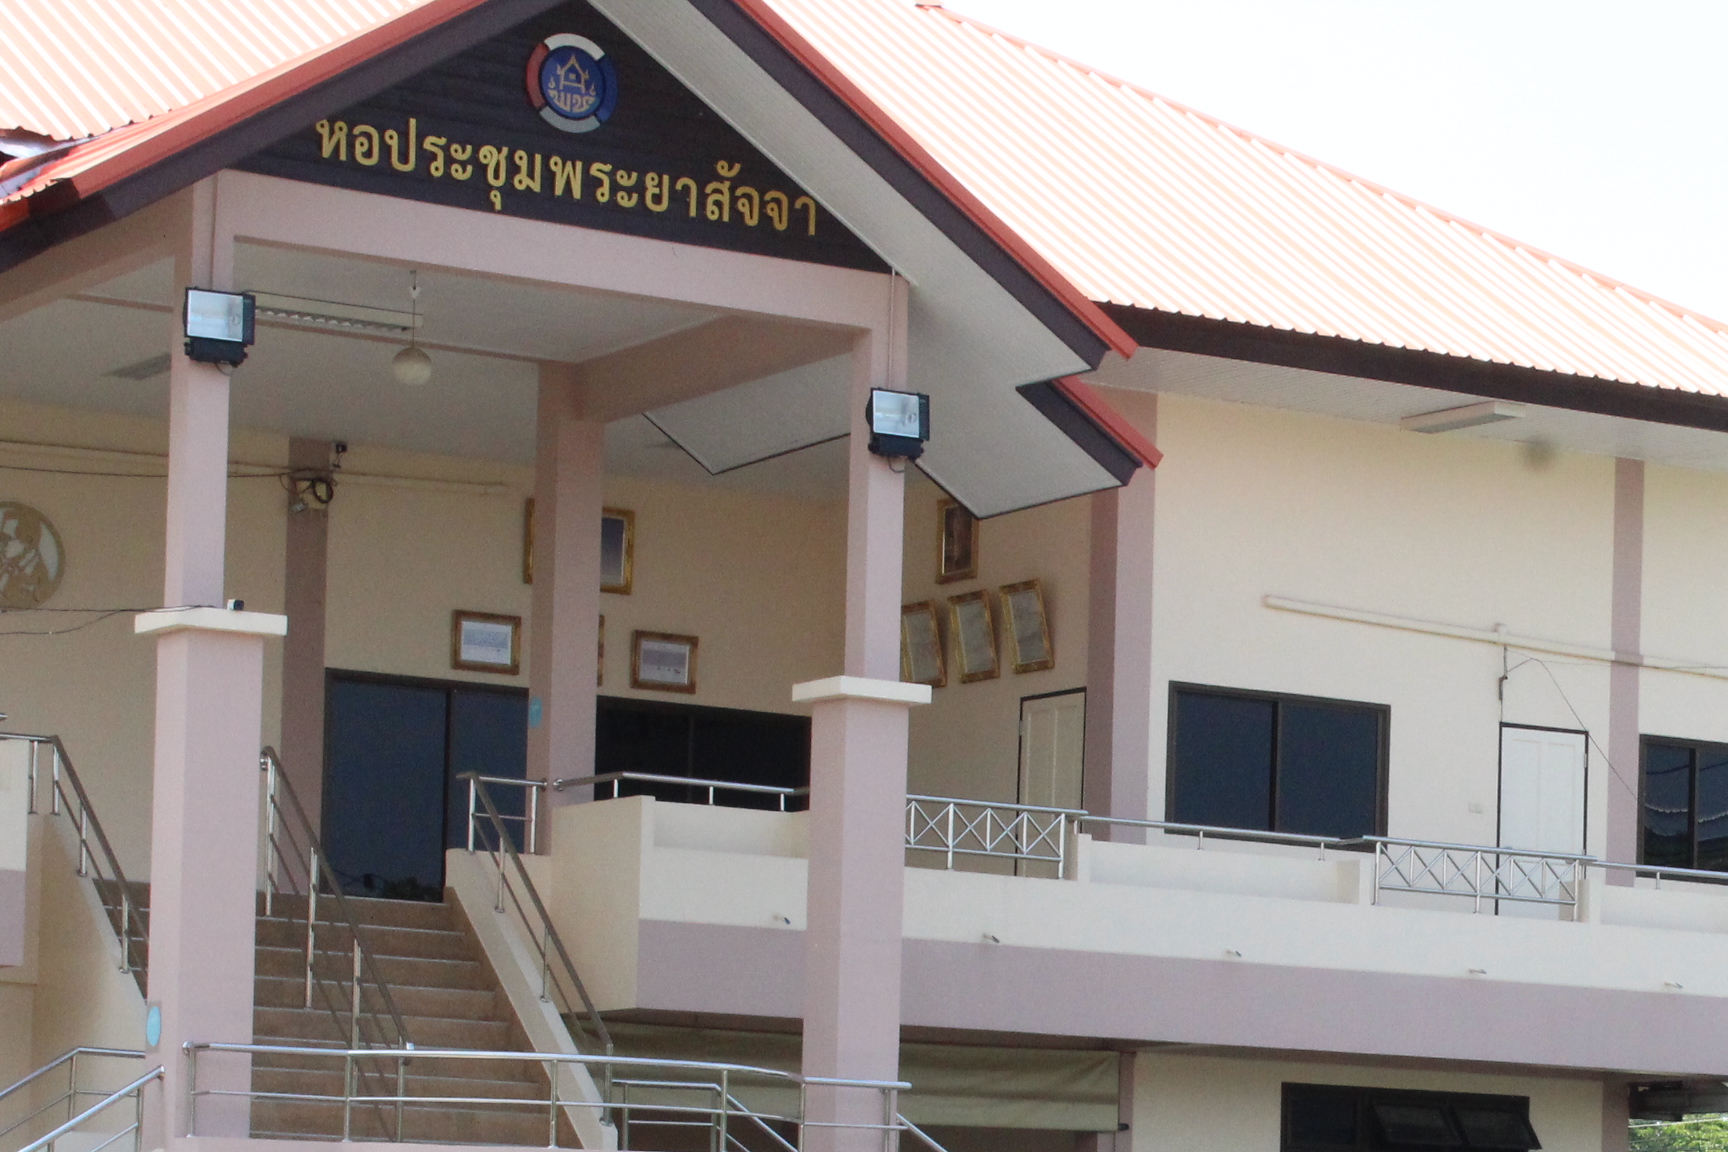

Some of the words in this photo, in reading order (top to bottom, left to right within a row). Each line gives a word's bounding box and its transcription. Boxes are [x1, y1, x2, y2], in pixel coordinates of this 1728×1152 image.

[315, 117, 817, 236] หอประชุมพระยาสัจจา
